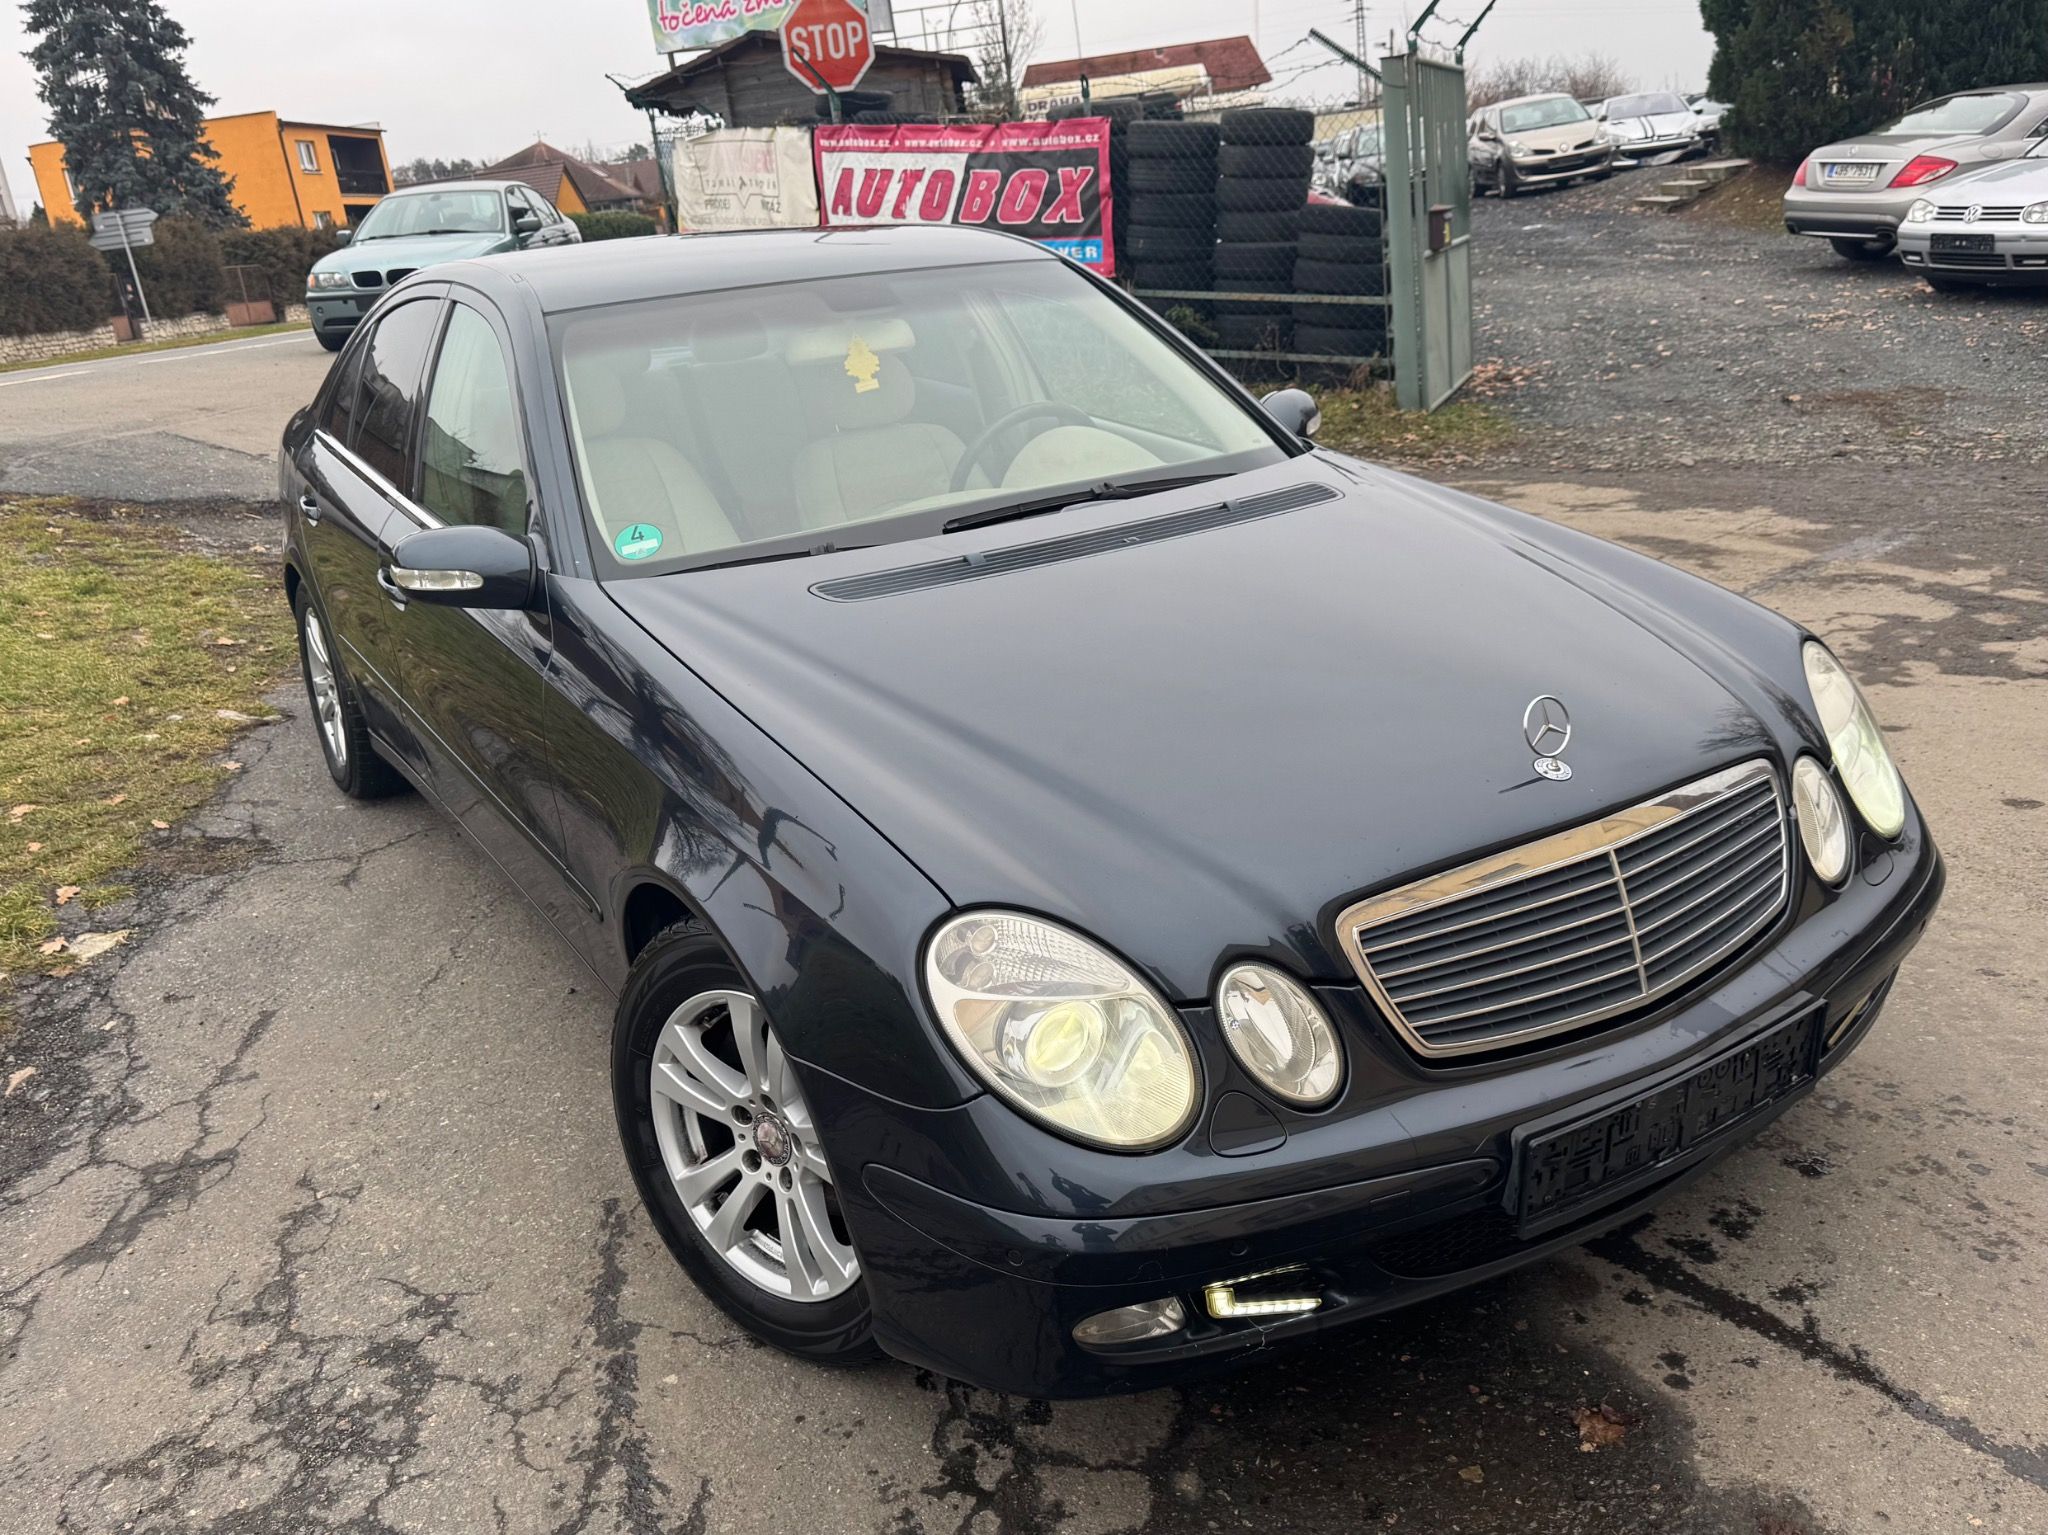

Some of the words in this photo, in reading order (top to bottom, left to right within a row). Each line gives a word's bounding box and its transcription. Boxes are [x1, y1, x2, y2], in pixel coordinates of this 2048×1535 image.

[791, 21, 863, 63] STOP
[1002, 134, 1100, 146] www.autobox.cz
[831, 166, 1094, 224] AUTOBOX
[1057, 245, 1098, 258] VER
[630, 525, 645, 541] 4
